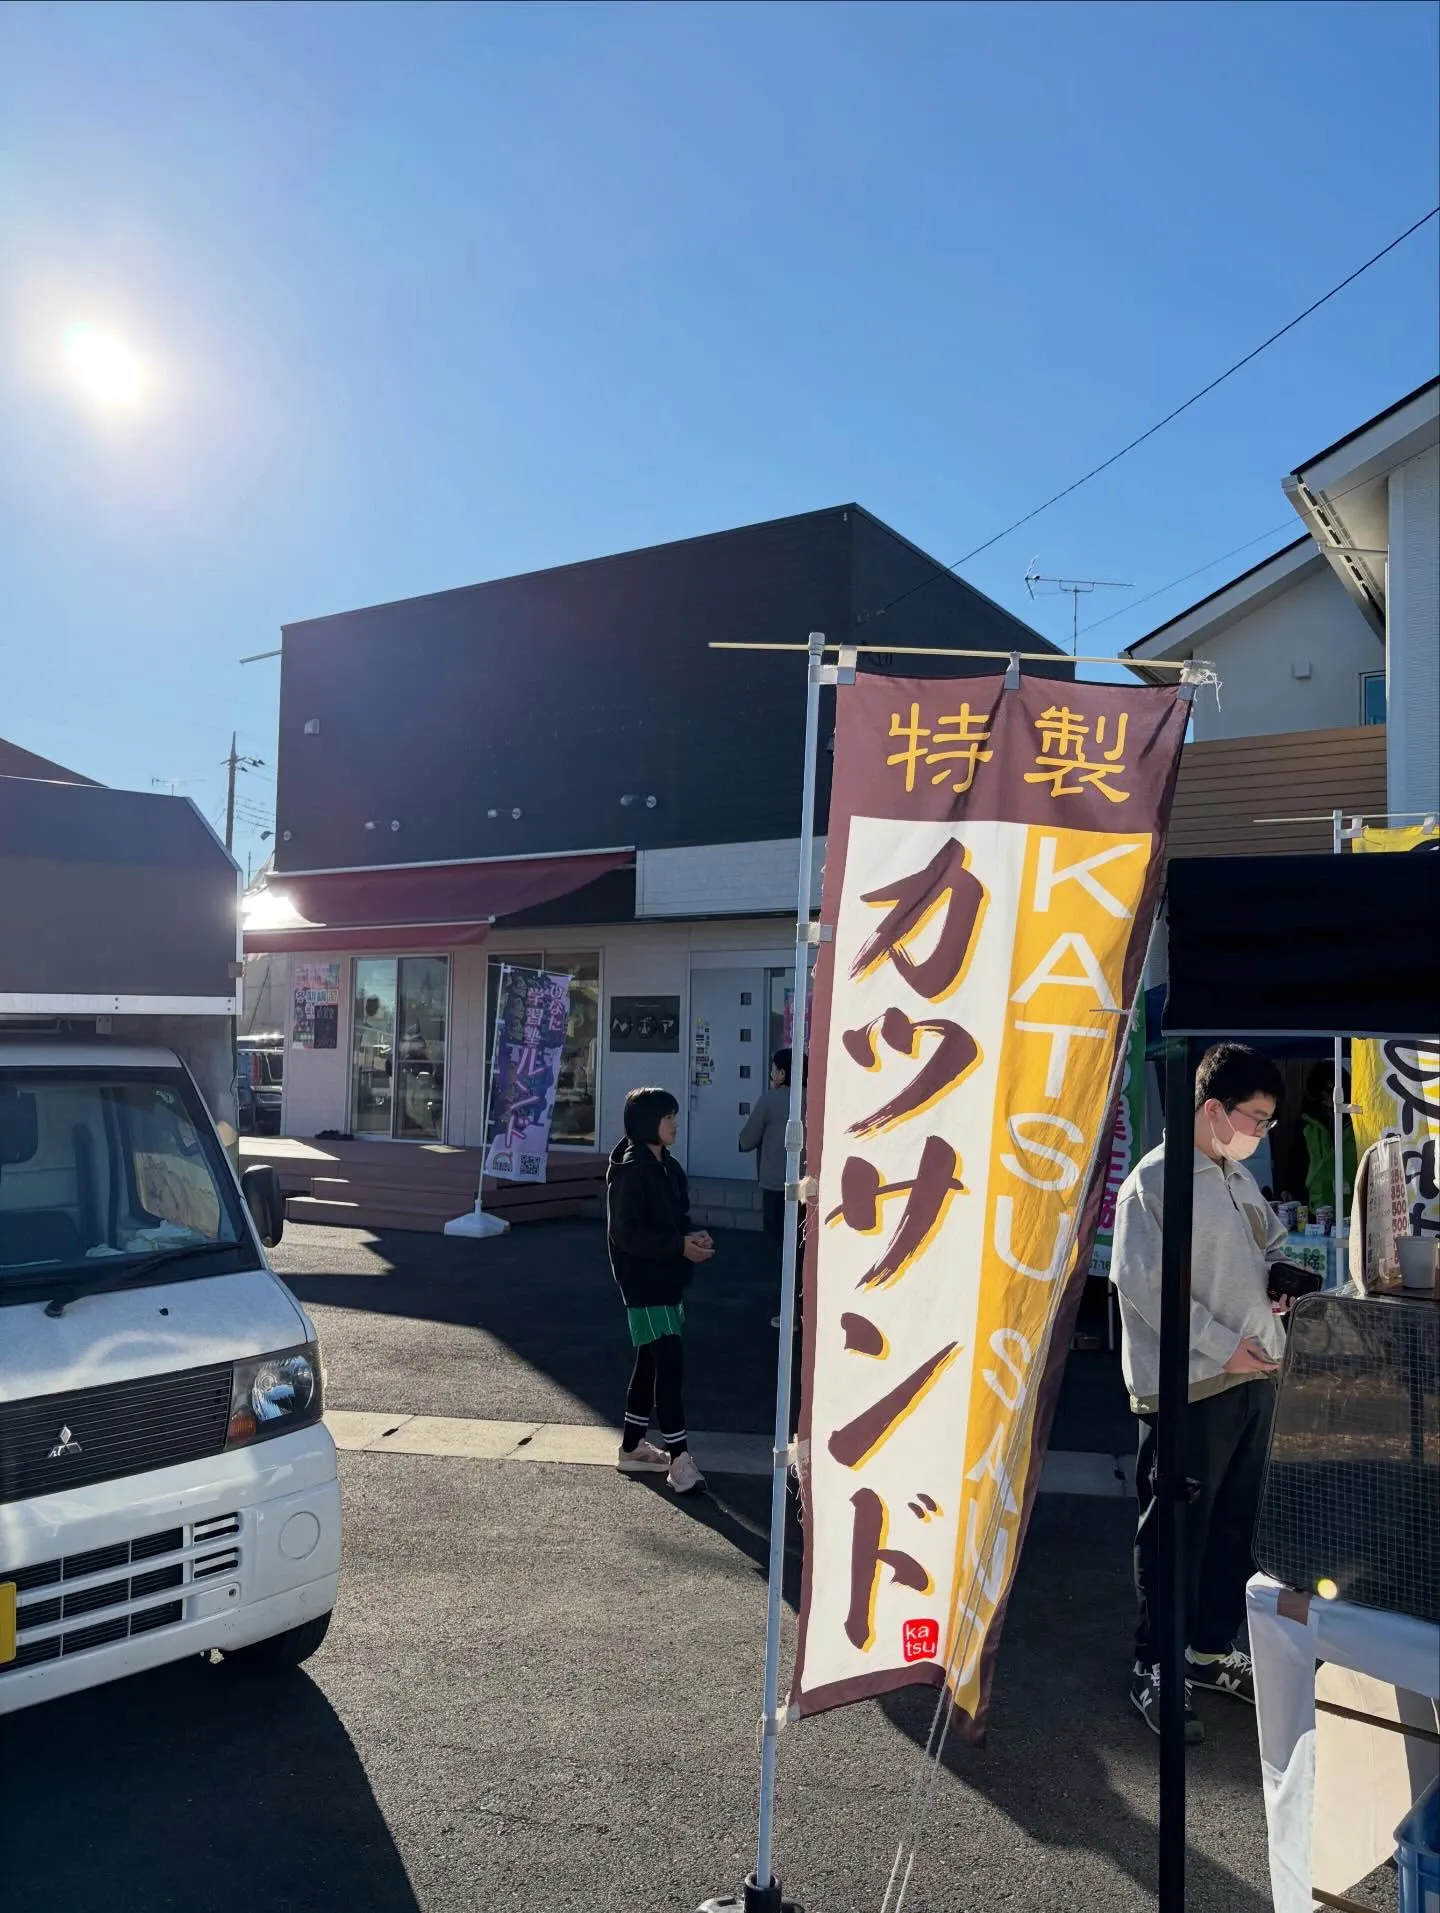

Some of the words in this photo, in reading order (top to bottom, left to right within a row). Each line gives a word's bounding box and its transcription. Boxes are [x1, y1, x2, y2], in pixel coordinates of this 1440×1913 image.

[886, 702, 1131, 803] 特製
[993, 836, 1145, 1281] KATSU
[824, 837, 991, 1653] カツサンド
[906, 1623, 930, 1640] ka
[906, 1641, 935, 1656] tsu
